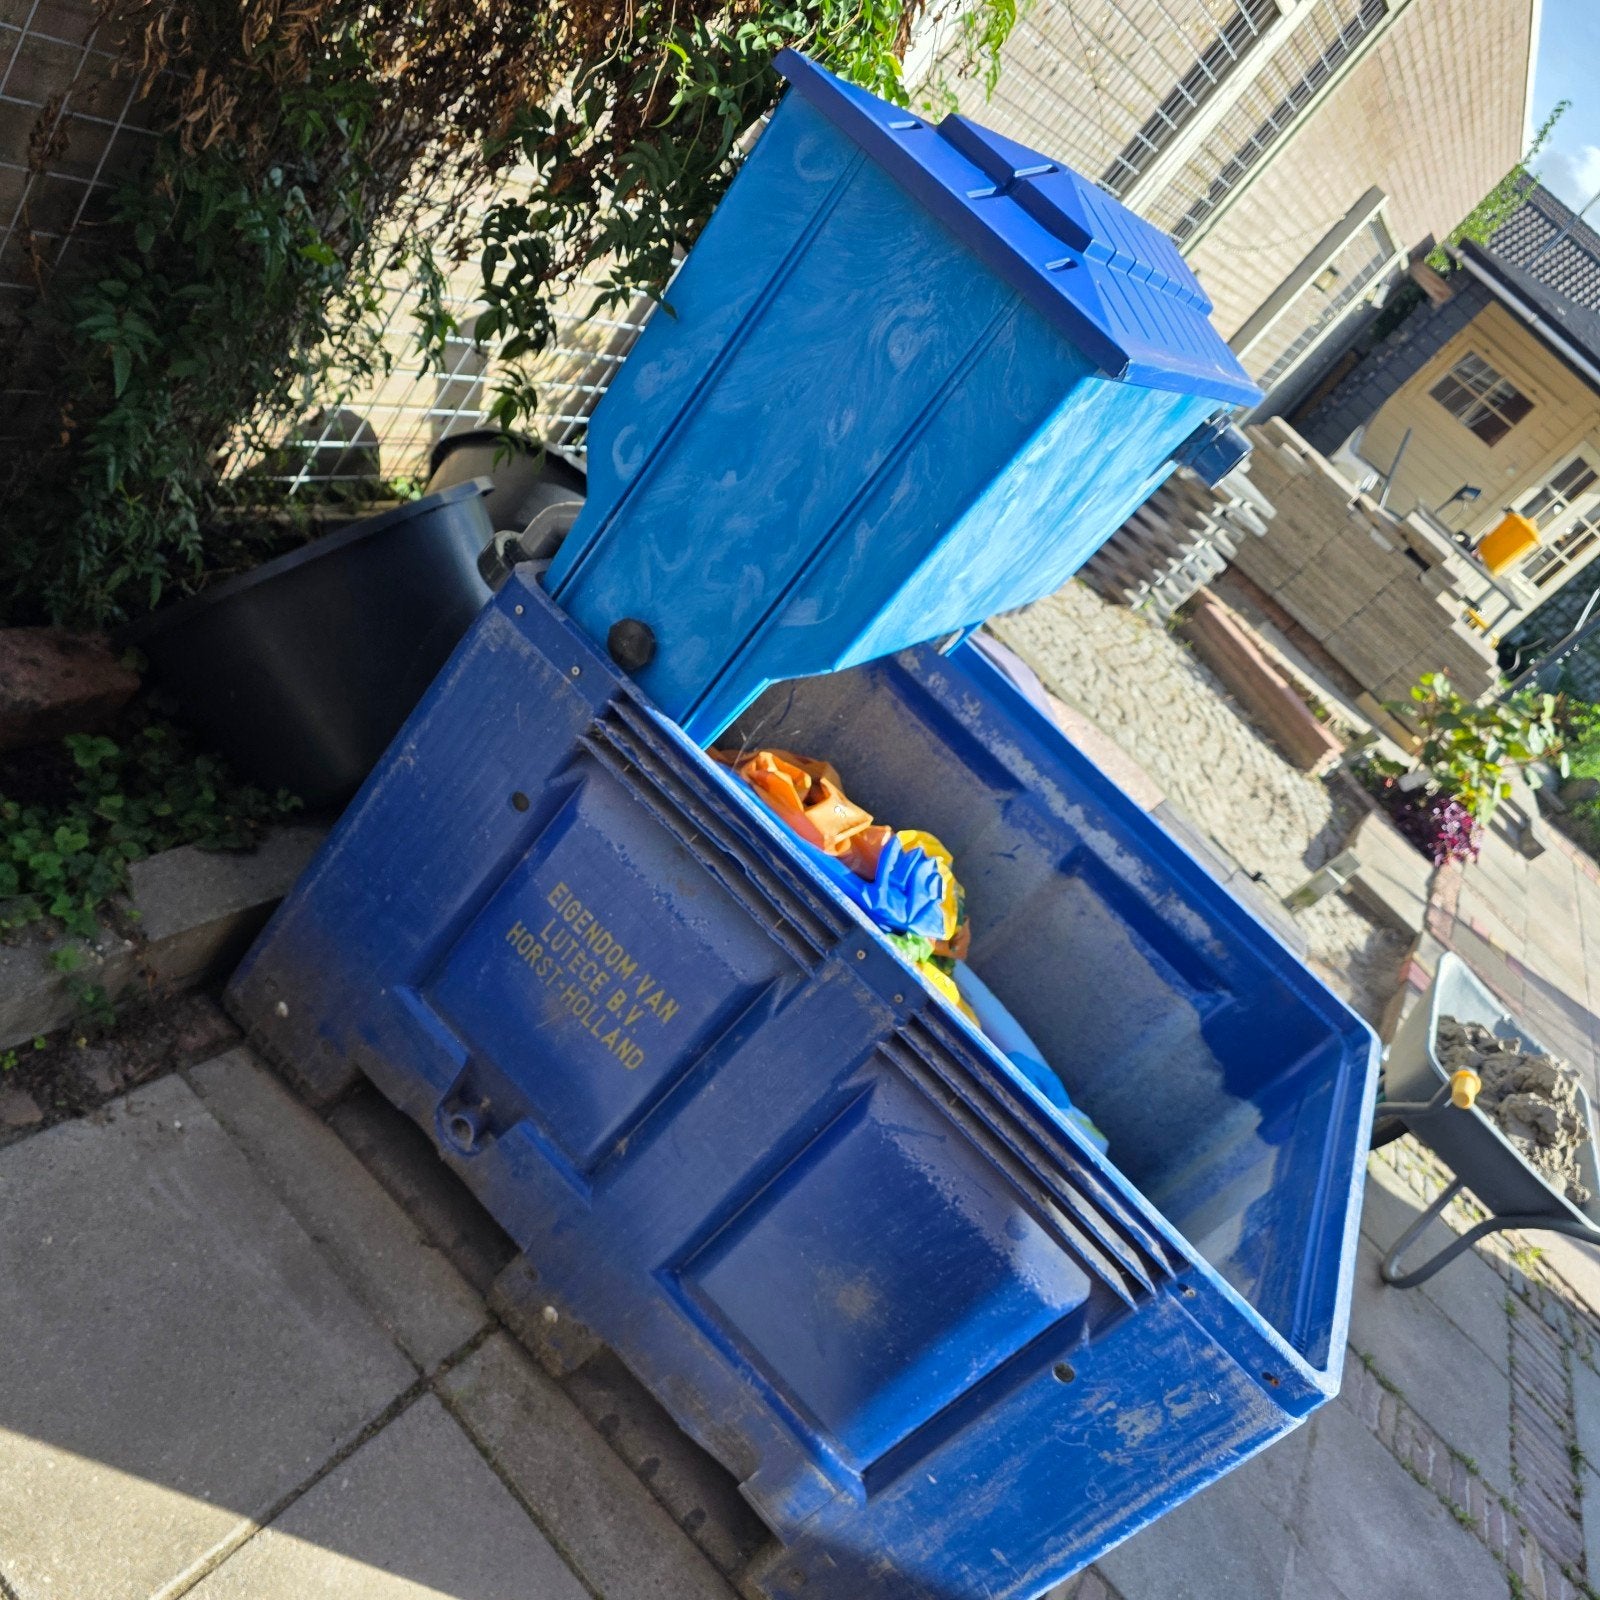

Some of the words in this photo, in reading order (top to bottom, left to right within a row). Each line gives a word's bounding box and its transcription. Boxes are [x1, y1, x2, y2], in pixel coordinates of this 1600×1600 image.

[505, 920, 645, 1071] HORST-HOLLAND
[547, 881, 638, 981] EIGENDOM
[635, 974, 680, 1025] VAN
[605, 988, 645, 1035] B.V.
